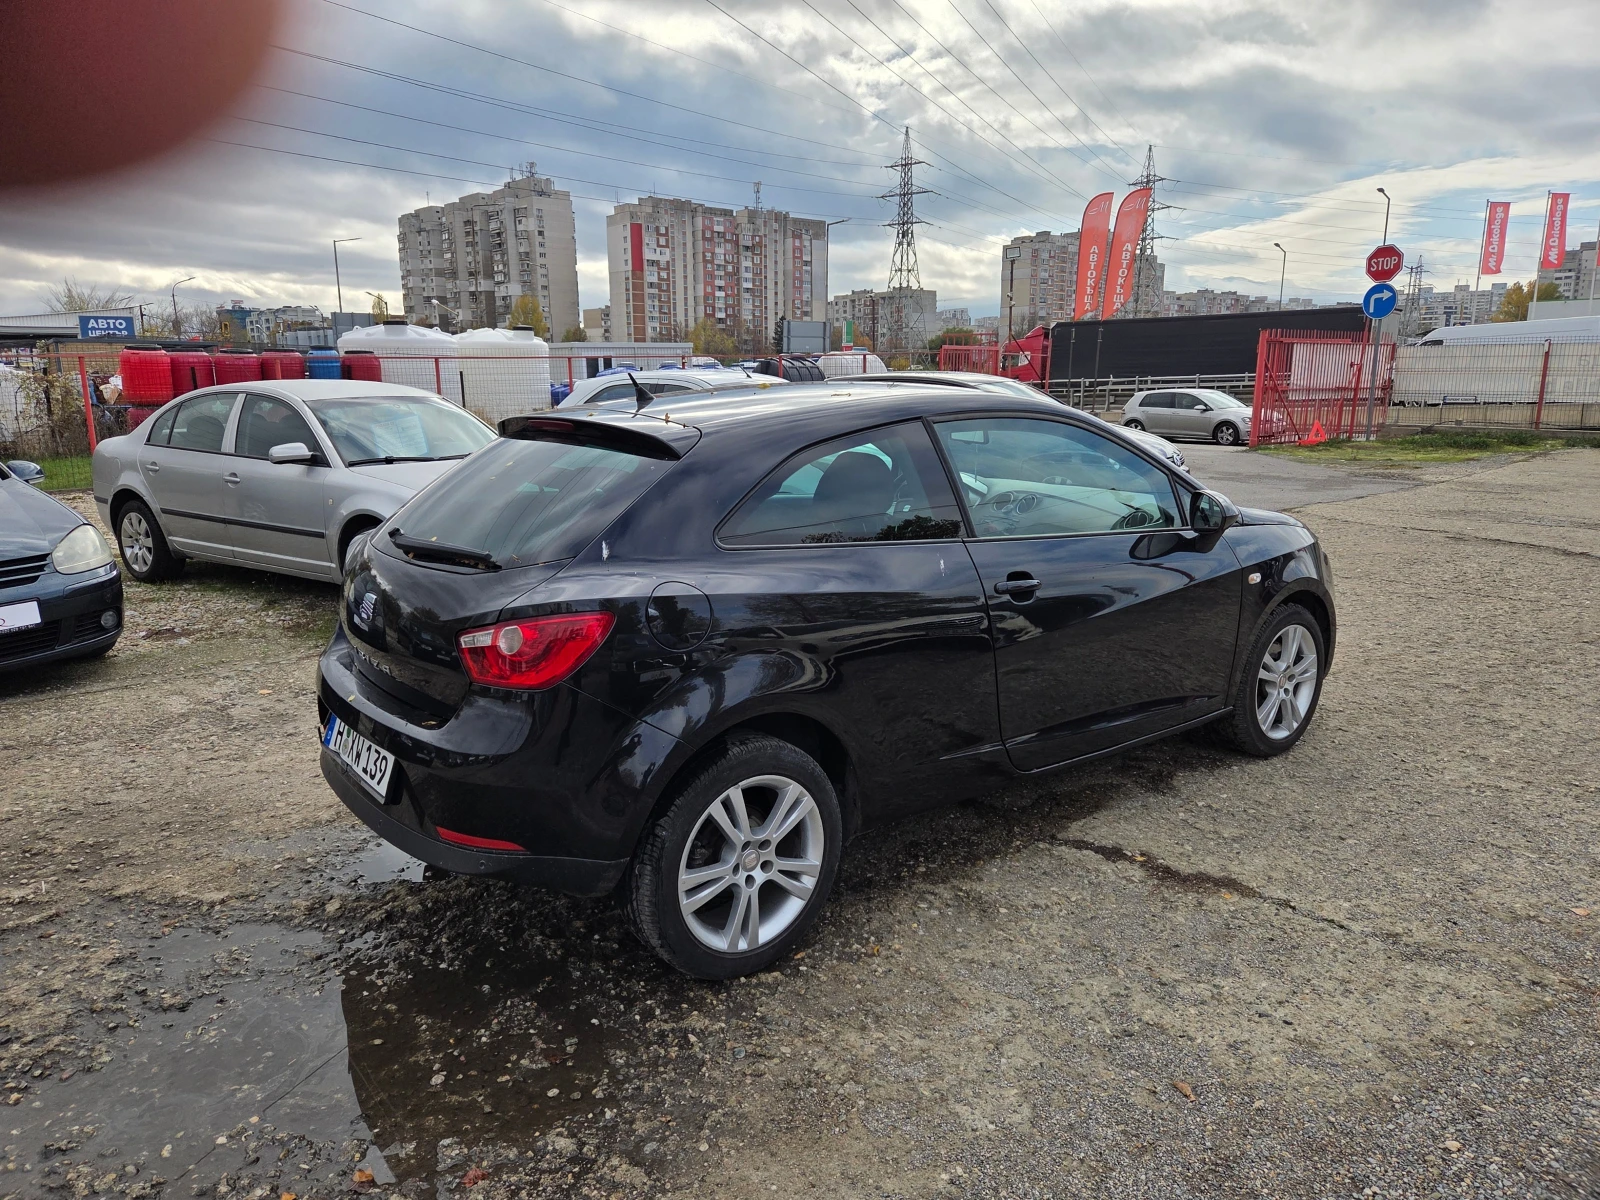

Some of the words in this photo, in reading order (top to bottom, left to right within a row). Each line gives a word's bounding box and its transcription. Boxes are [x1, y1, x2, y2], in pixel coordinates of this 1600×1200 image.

[1084, 245, 1098, 310] АВТОКЪЩА
[1113, 243, 1131, 309] АВТОКЪЩА
[1370, 256, 1398, 271] STOP
[88, 318, 126, 328] АВТО
[361, 743, 389, 786] 139
